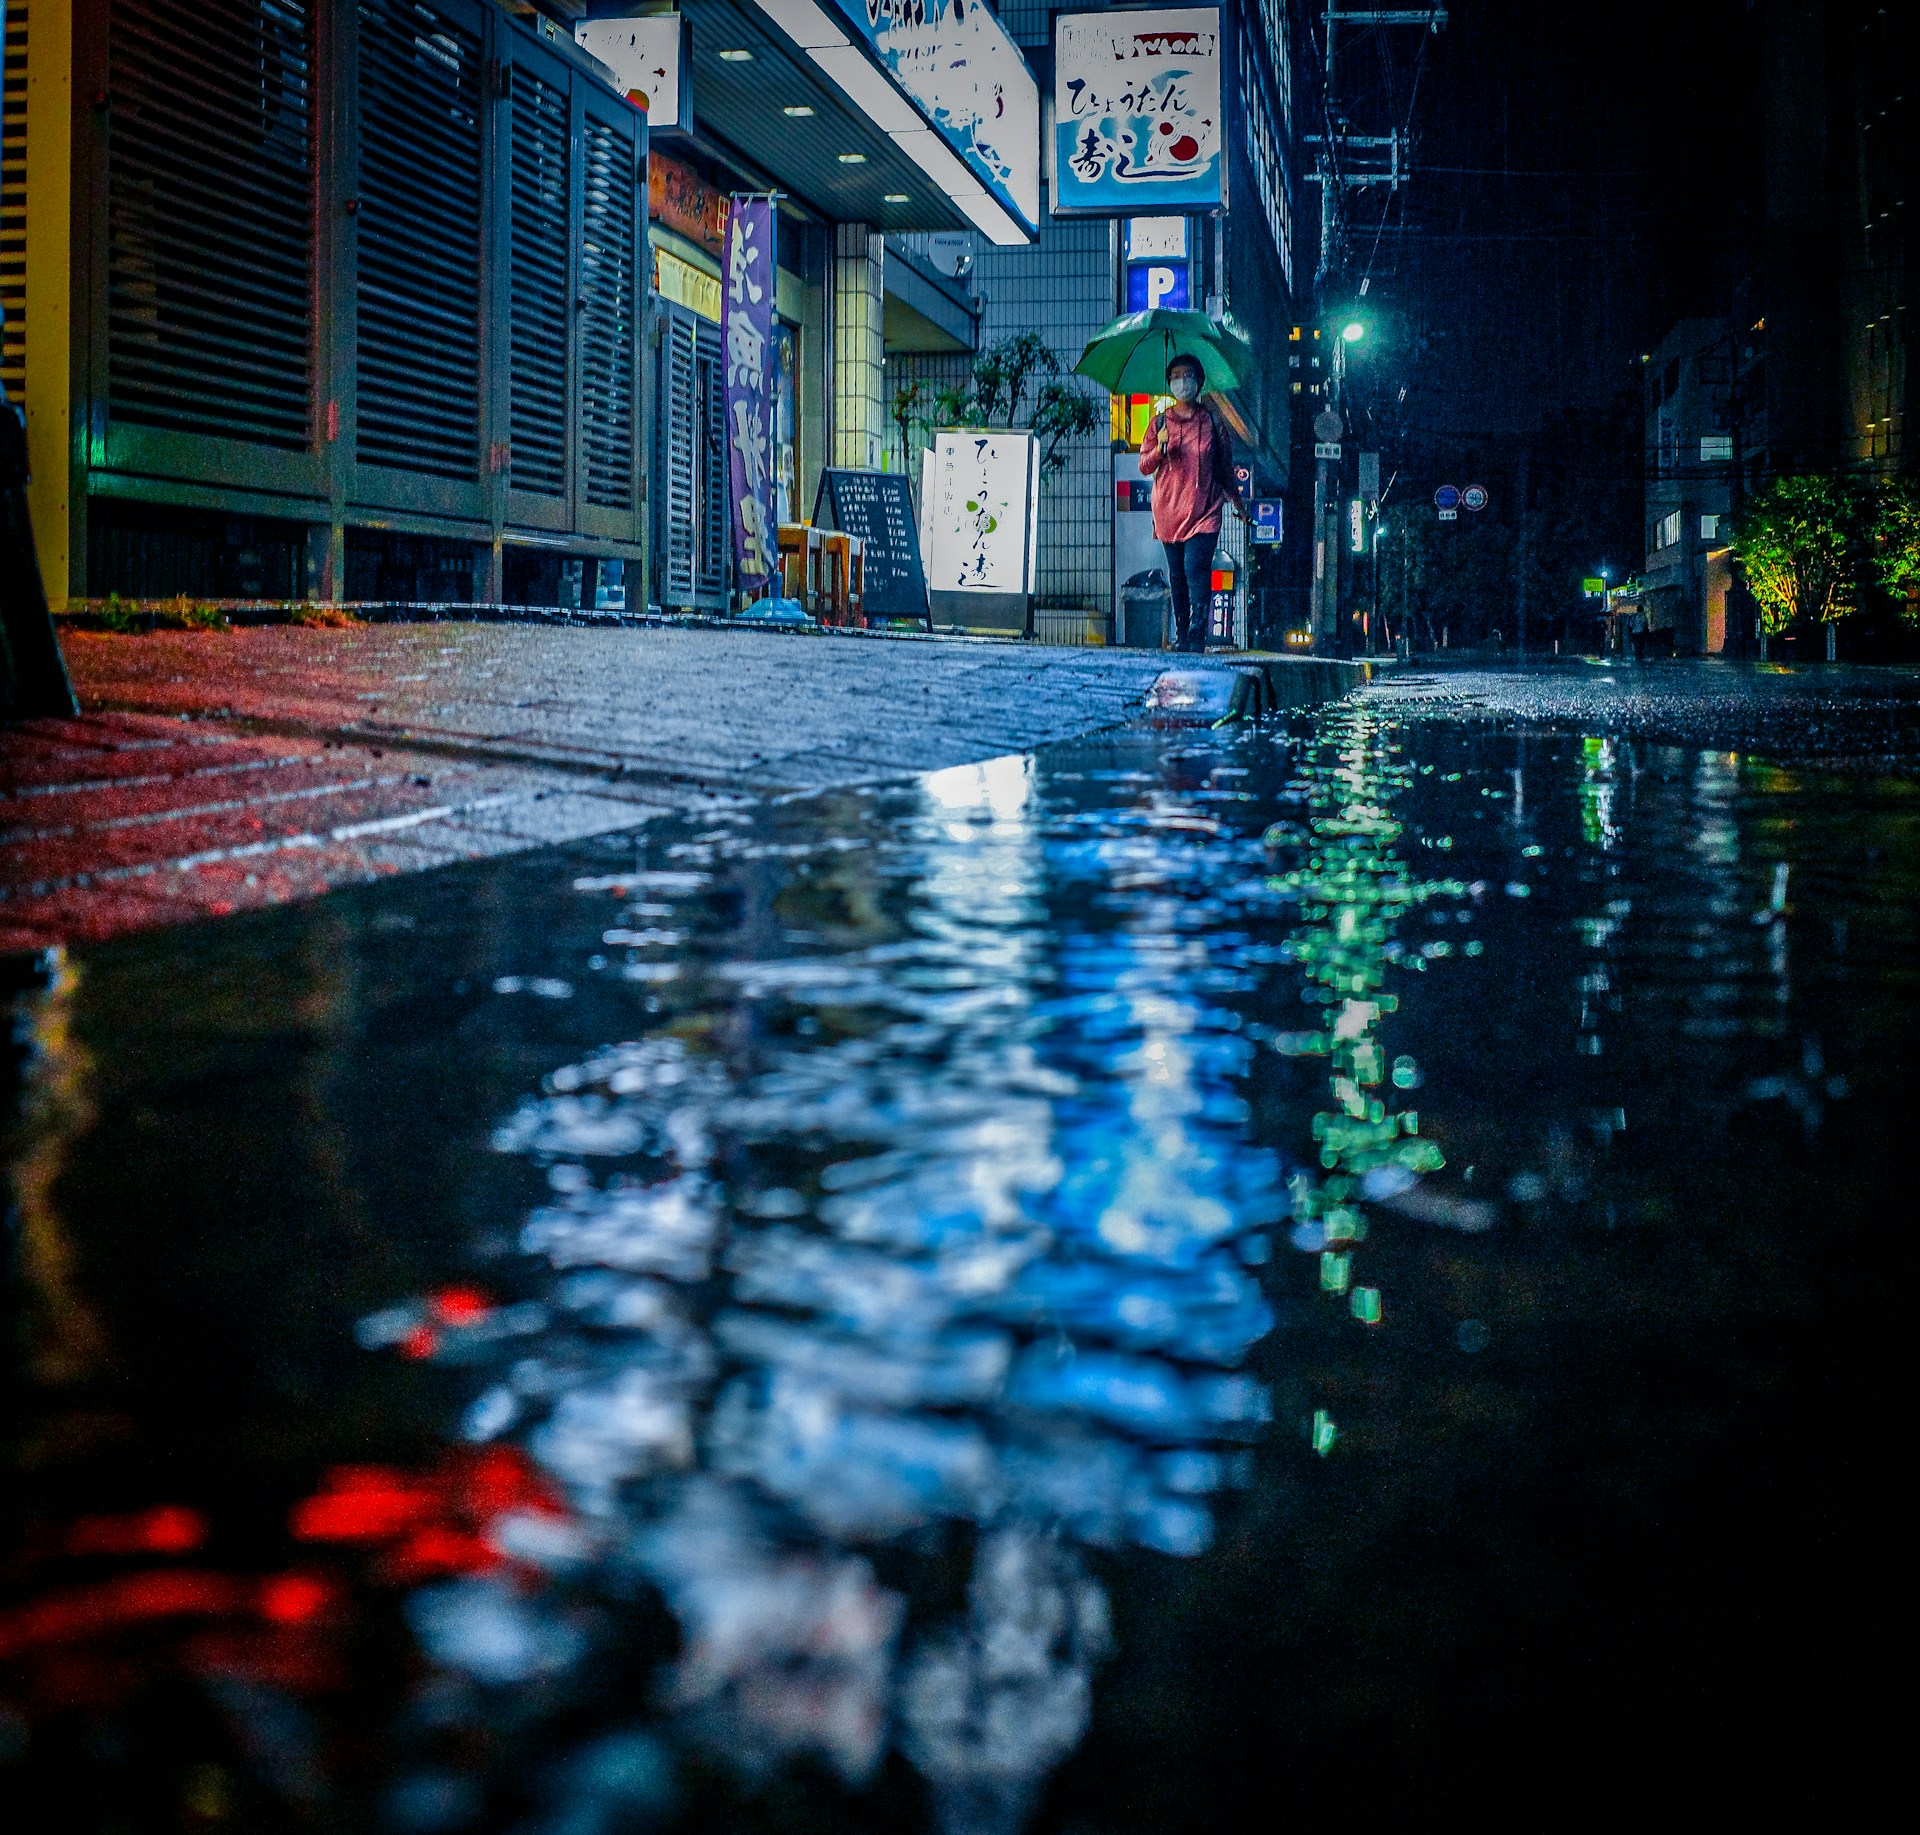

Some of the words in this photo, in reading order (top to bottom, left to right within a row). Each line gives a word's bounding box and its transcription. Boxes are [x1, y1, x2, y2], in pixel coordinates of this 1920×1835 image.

[1066, 78, 1190, 115] ひょうたん
[1147, 266, 1176, 309] P
[1258, 503, 1275, 521] P
